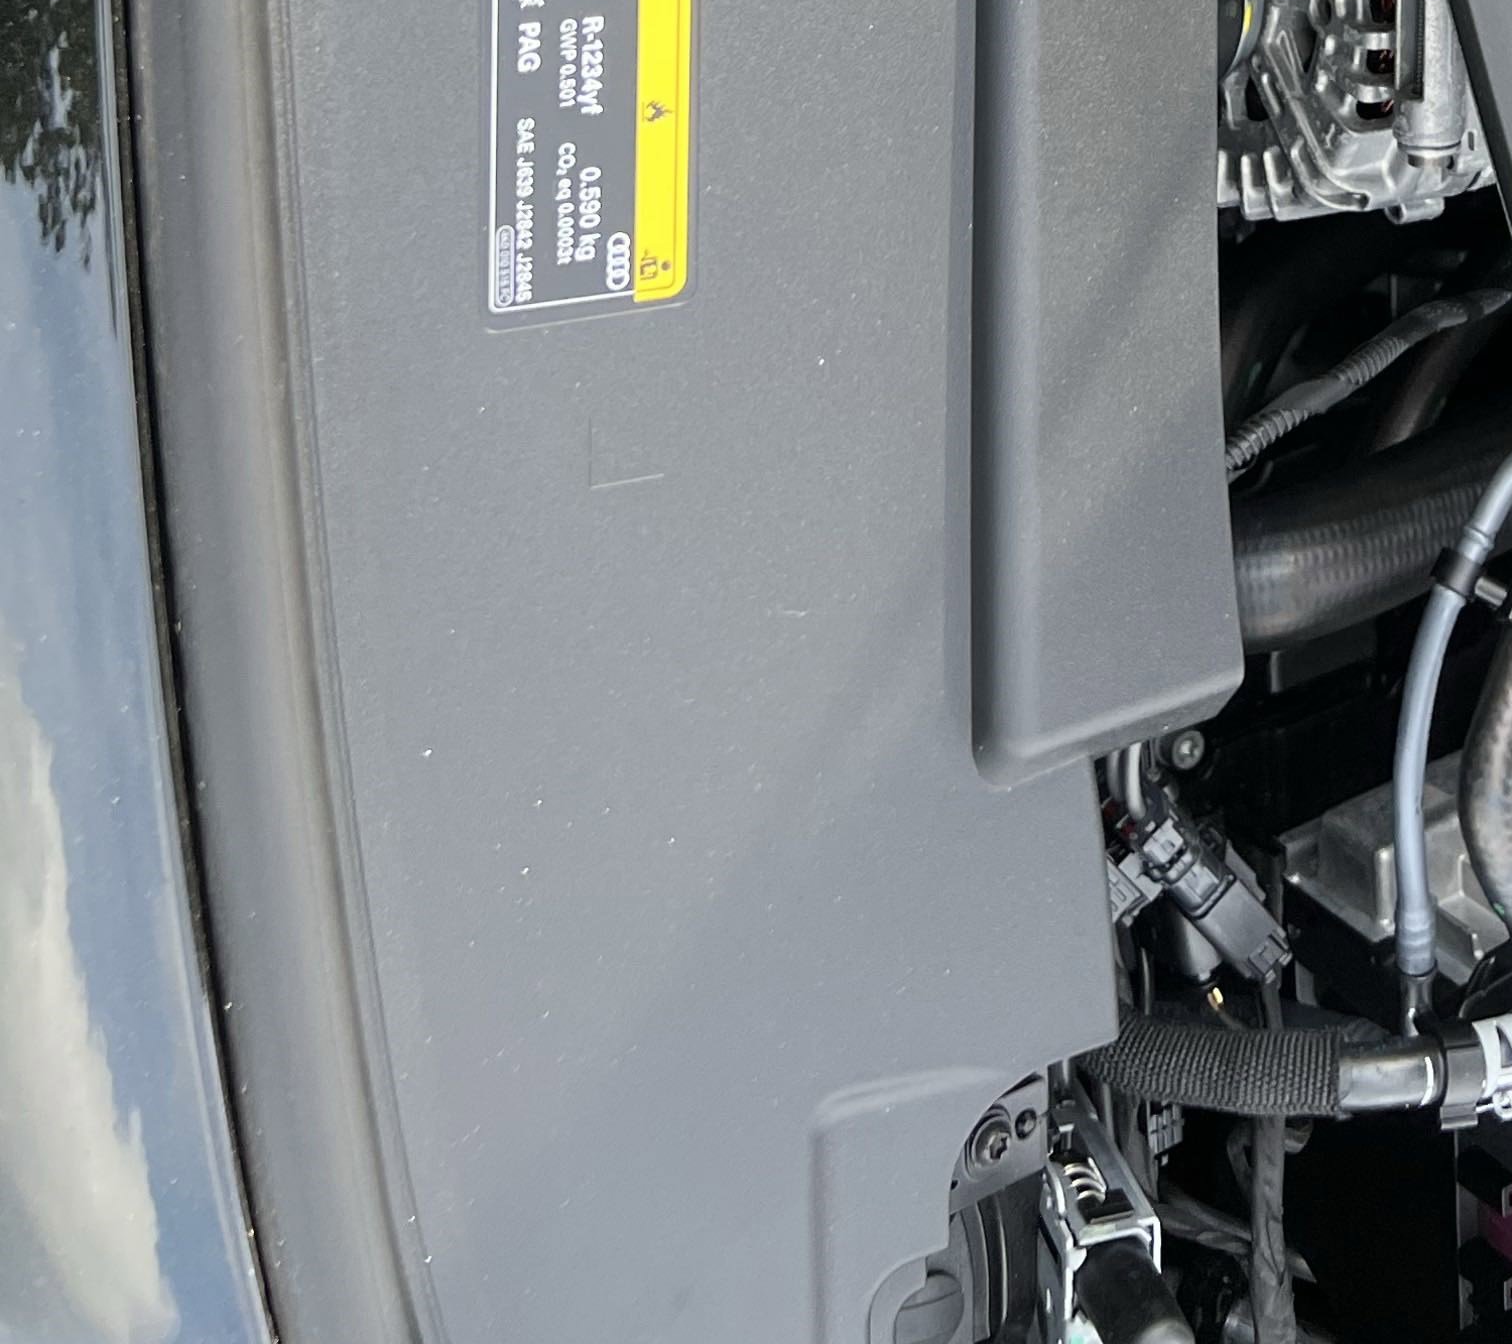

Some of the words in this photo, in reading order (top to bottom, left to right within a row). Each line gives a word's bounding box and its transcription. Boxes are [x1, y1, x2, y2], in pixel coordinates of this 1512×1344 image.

[516, 22, 541, 73] PAG
[559, 18, 578, 60] GWP
[558, 65, 577, 108] 0.501
[577, 15, 605, 117] R-1234yf
[515, 117, 534, 155] SAE
[515, 158, 534, 197] J639
[553, 178, 574, 201] eq
[579, 167, 602, 228] 0.590
[515, 201, 533, 251] J2842
[574, 234, 601, 262] kg
